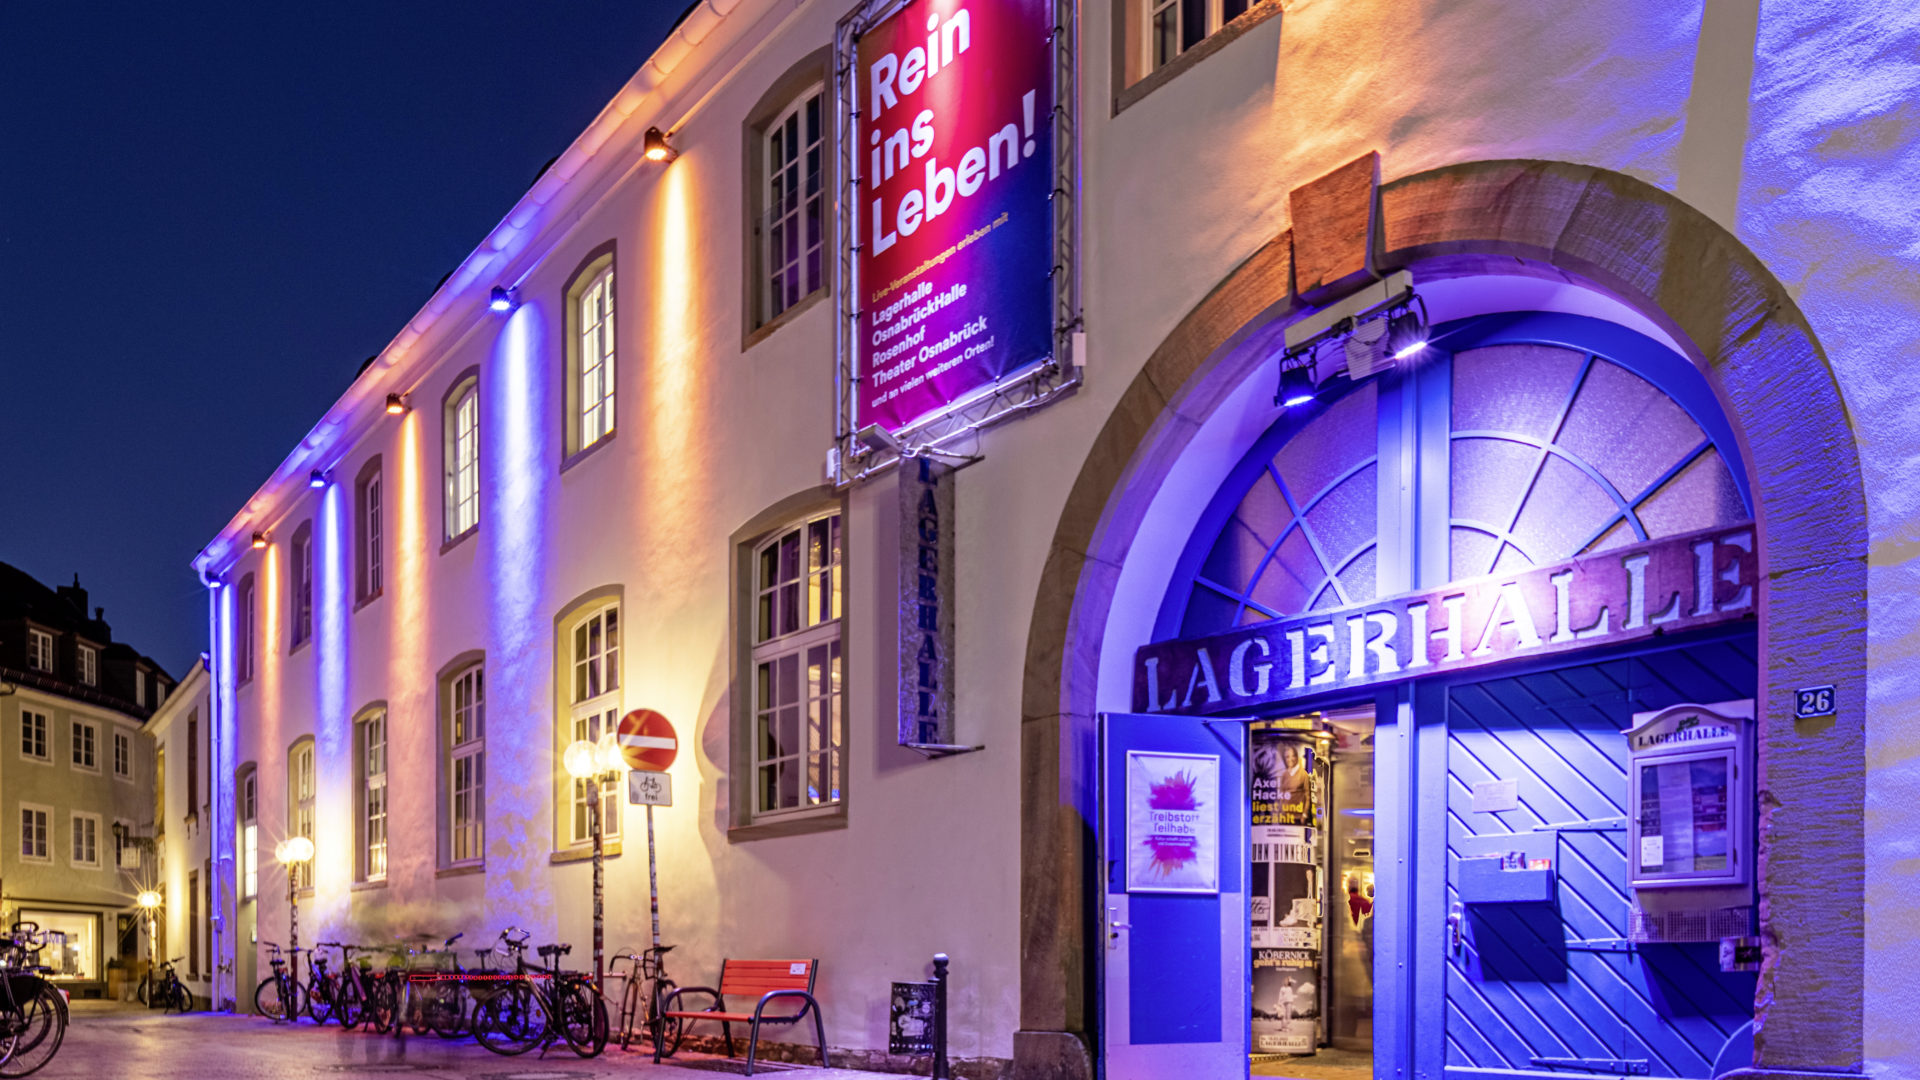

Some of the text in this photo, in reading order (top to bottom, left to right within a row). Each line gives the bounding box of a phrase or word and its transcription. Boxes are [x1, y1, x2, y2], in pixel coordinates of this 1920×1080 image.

[870, 8, 970, 122] Rein
[870, 109, 935, 190] ins
[872, 89, 1037, 258] Leben!
[872, 281, 933, 326] Lagerhalle
[872, 283, 967, 345] OsnabrückHalle
[872, 324, 926, 368] Rosenhof
[872, 315, 988, 388] Theater Osnabrück
[925, 355, 963, 379] weiteren
[964, 335, 995, 360] Orten!
[1143, 531, 1753, 713] LAGERHALLE
[1801, 690, 1830, 714] 26
[1638, 725, 1729, 746] LAGERHALLE
[645, 793, 658, 801] frei
[1252, 789, 1292, 800] Hacke
[1253, 777, 1281, 789] Axel
[1252, 801, 1304, 813] liest und
[1252, 813, 1296, 824] erzählt
